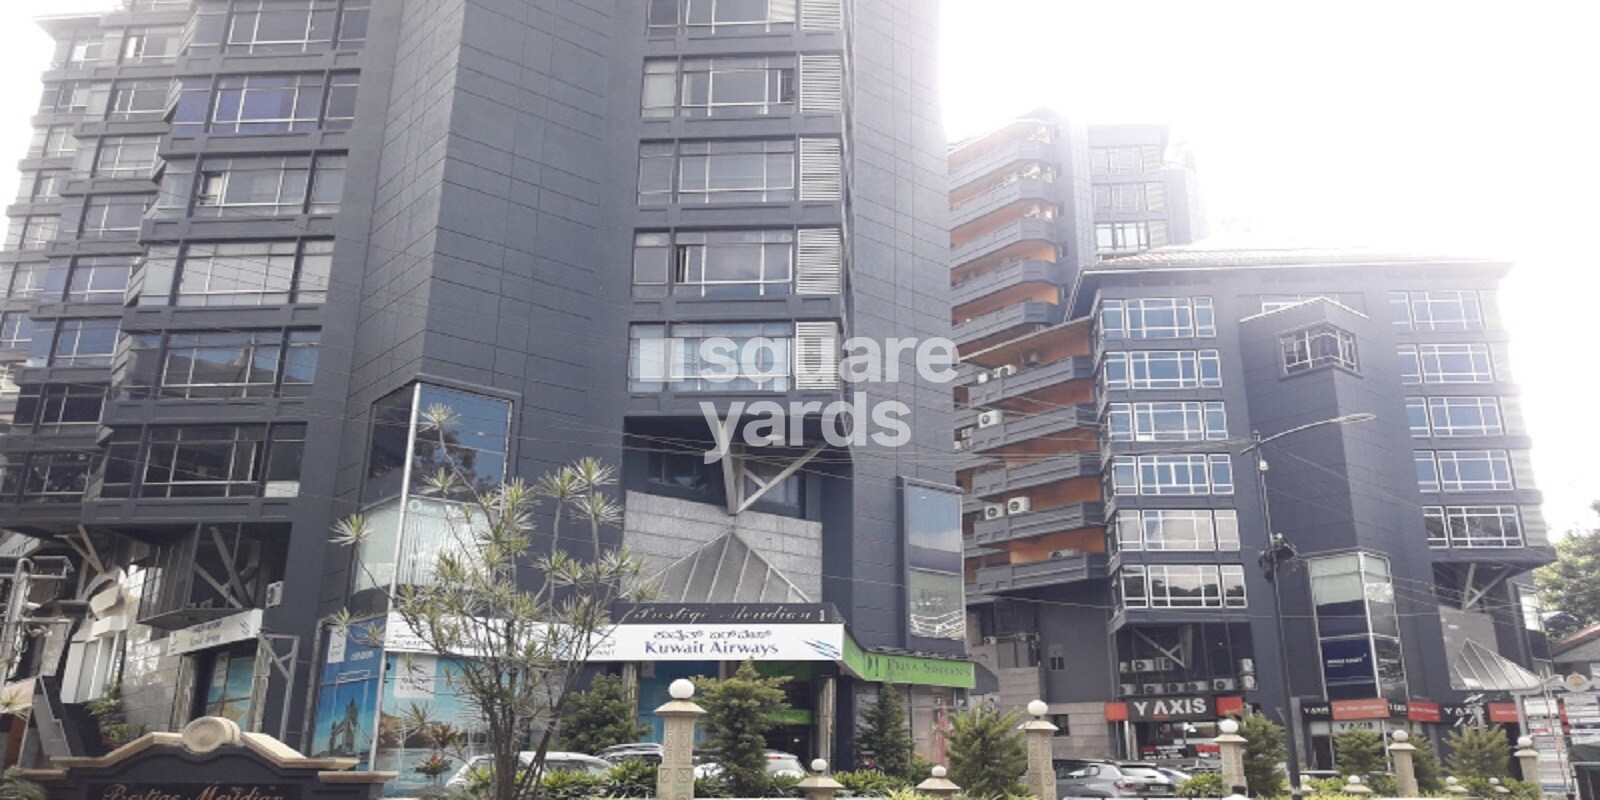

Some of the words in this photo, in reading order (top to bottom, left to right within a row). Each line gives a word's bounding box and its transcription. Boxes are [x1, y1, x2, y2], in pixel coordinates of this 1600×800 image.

[645, 640, 705, 654] Kuwait
[710, 640, 779, 657] Airways
[1153, 698, 1207, 715] AXIS
